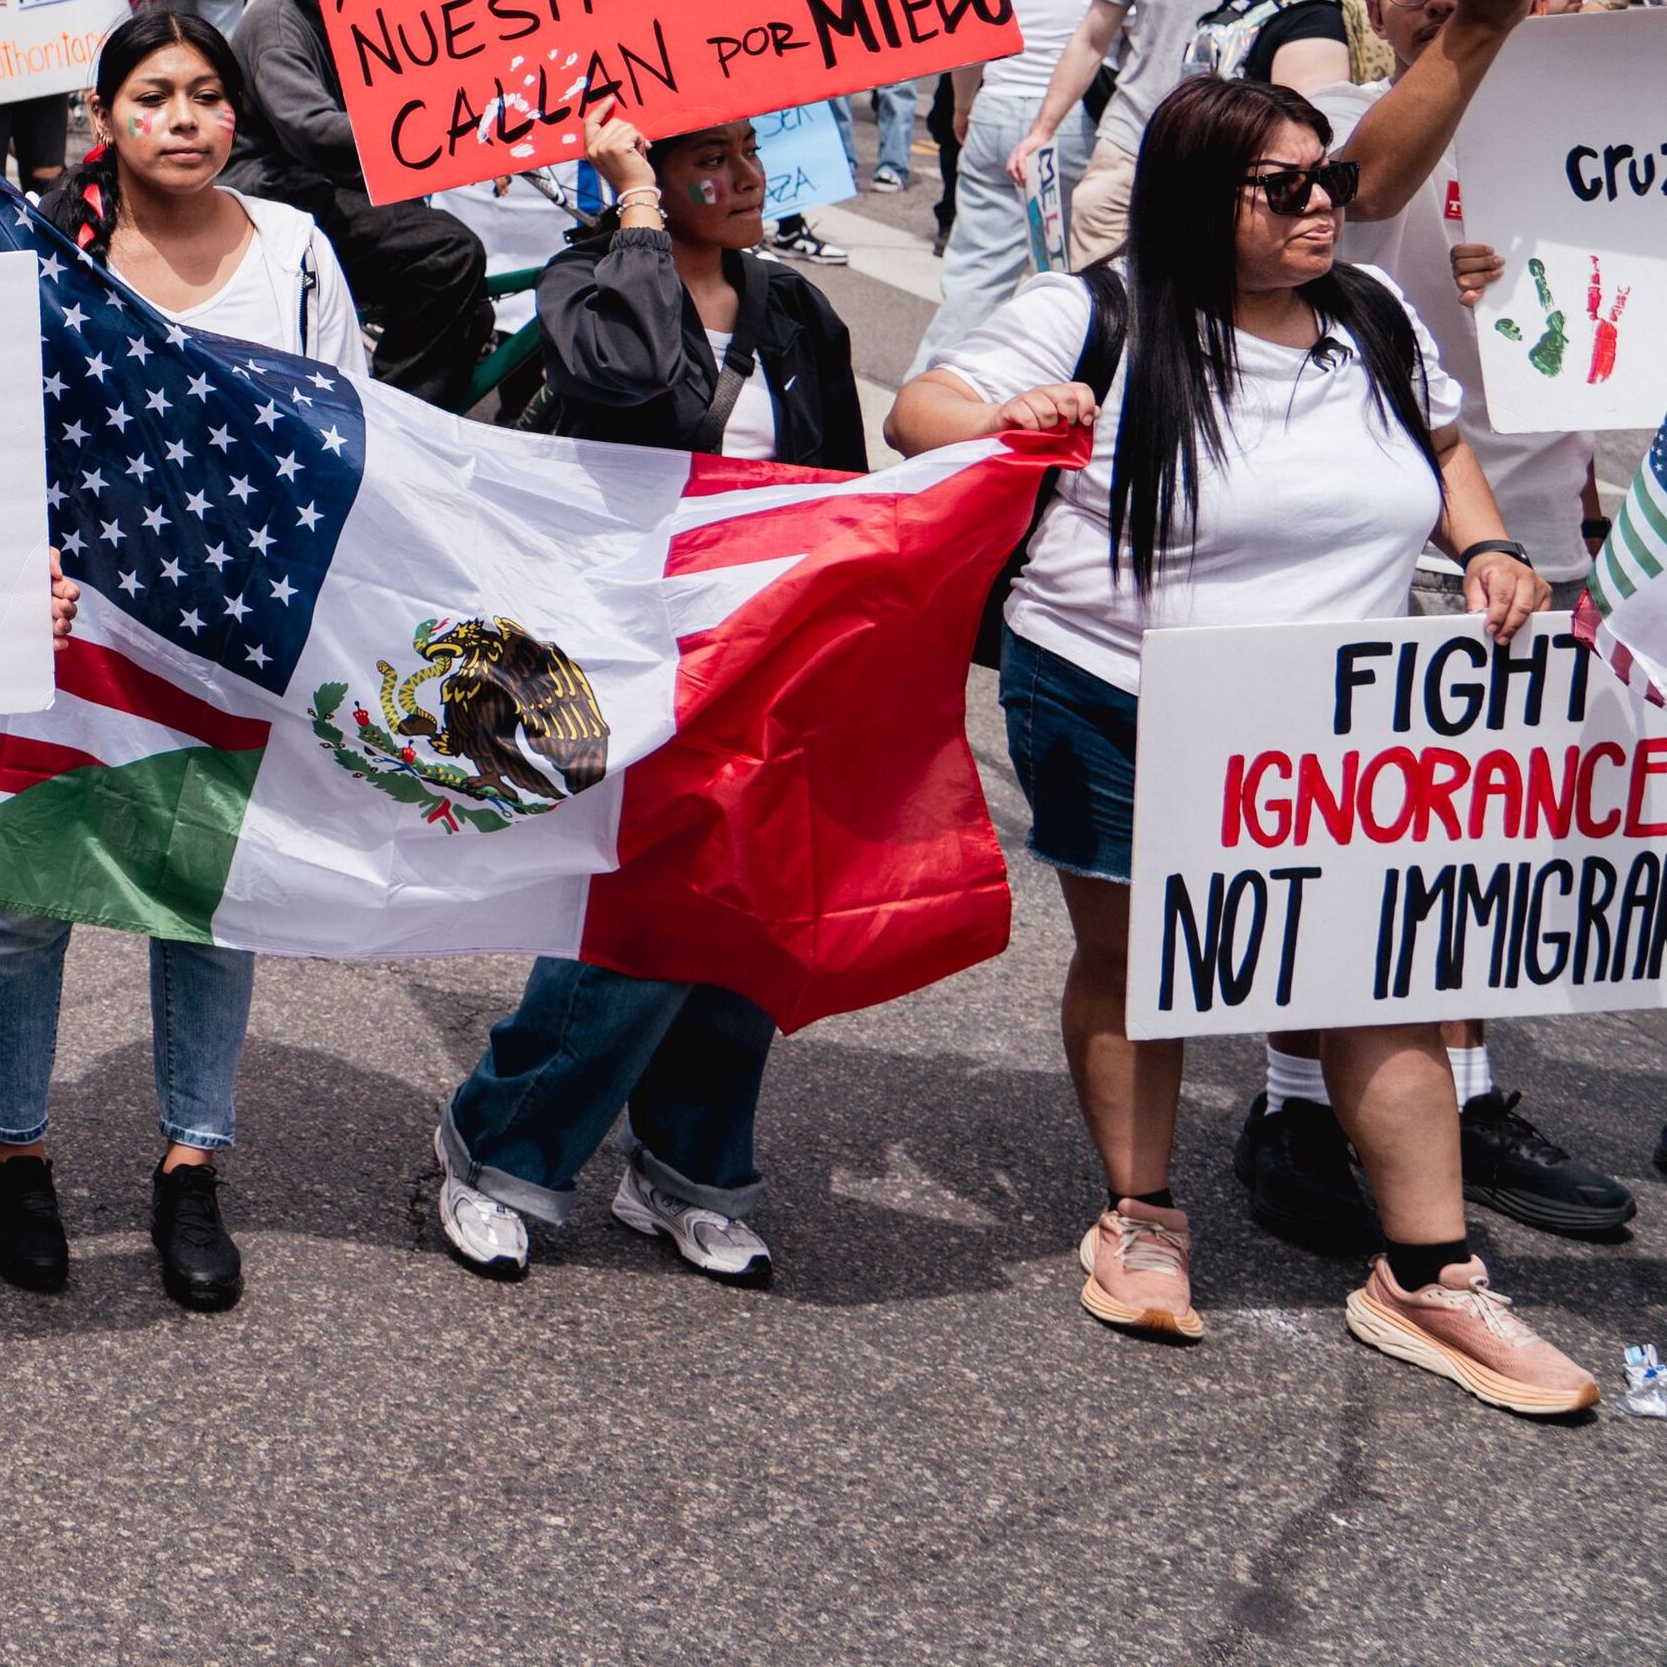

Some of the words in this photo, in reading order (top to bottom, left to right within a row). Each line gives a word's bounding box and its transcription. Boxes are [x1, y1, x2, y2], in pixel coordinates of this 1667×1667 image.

[391, 19, 679, 170] CALLAN
[1566, 144, 1667, 202] cru
[1333, 634, 1591, 737] FIGHT
[1221, 738, 1667, 848] IGNORANCE
[1158, 867, 1322, 1013] NOT
